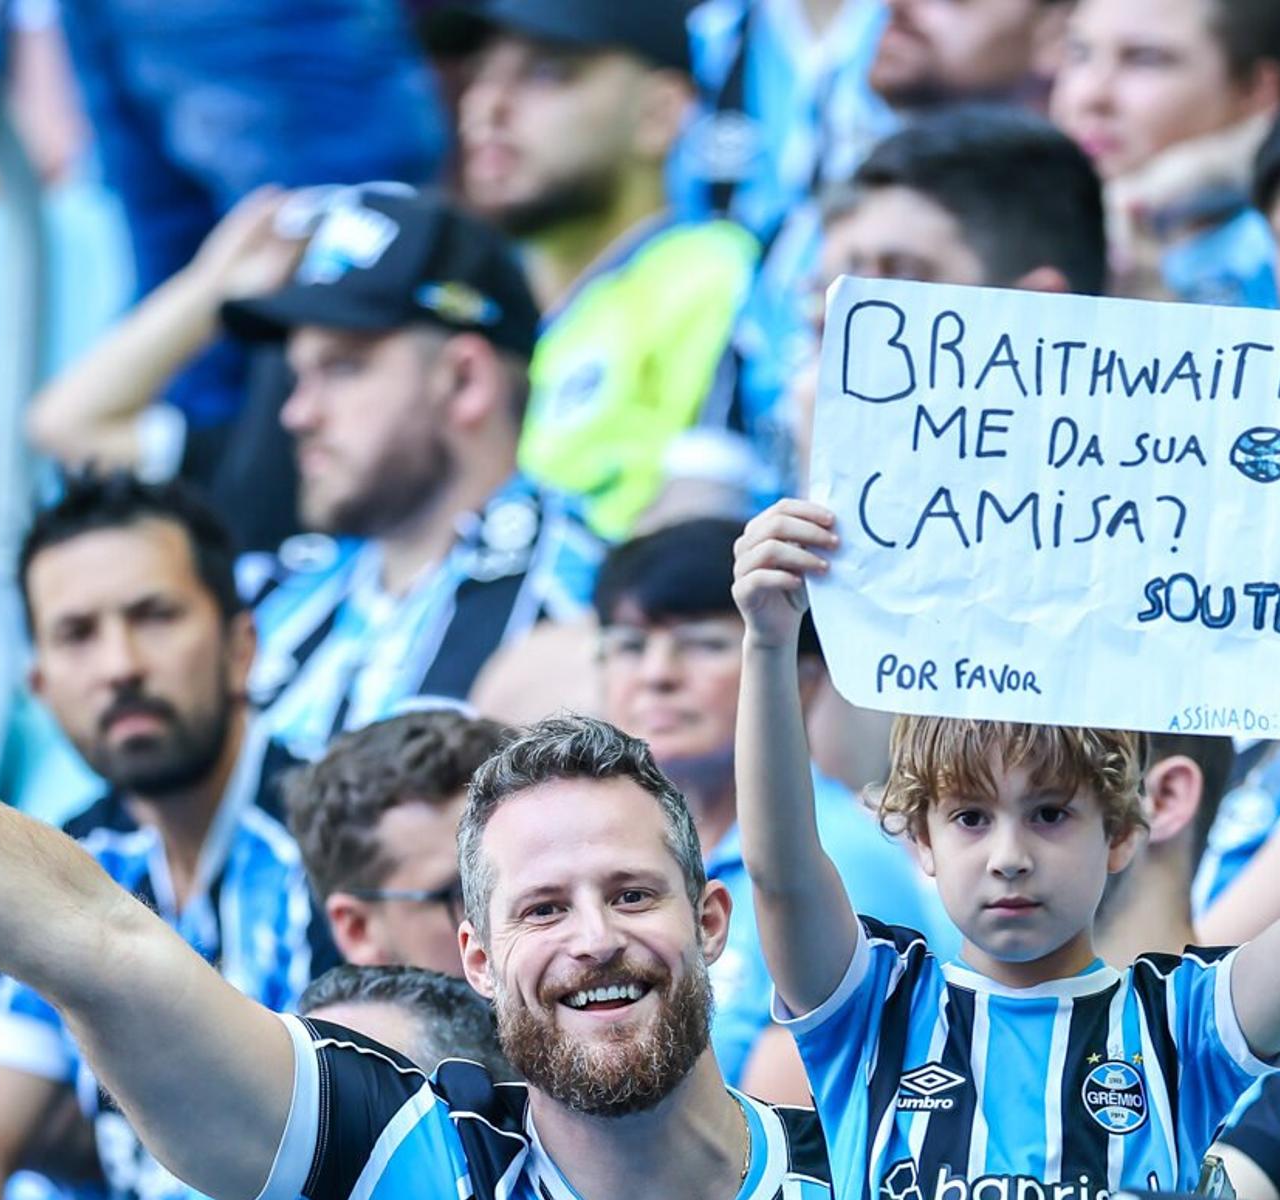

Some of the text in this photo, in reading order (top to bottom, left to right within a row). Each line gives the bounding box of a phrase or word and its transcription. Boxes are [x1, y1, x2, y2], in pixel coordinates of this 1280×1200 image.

[913, 404, 1207, 468] ME DA SUA
[1138, 573, 1236, 629] SOU
[877, 654, 1042, 694] POR FAVOR
[897, 1095, 954, 1110] umbro
[1087, 1089, 1143, 1108] GRÊMIO
